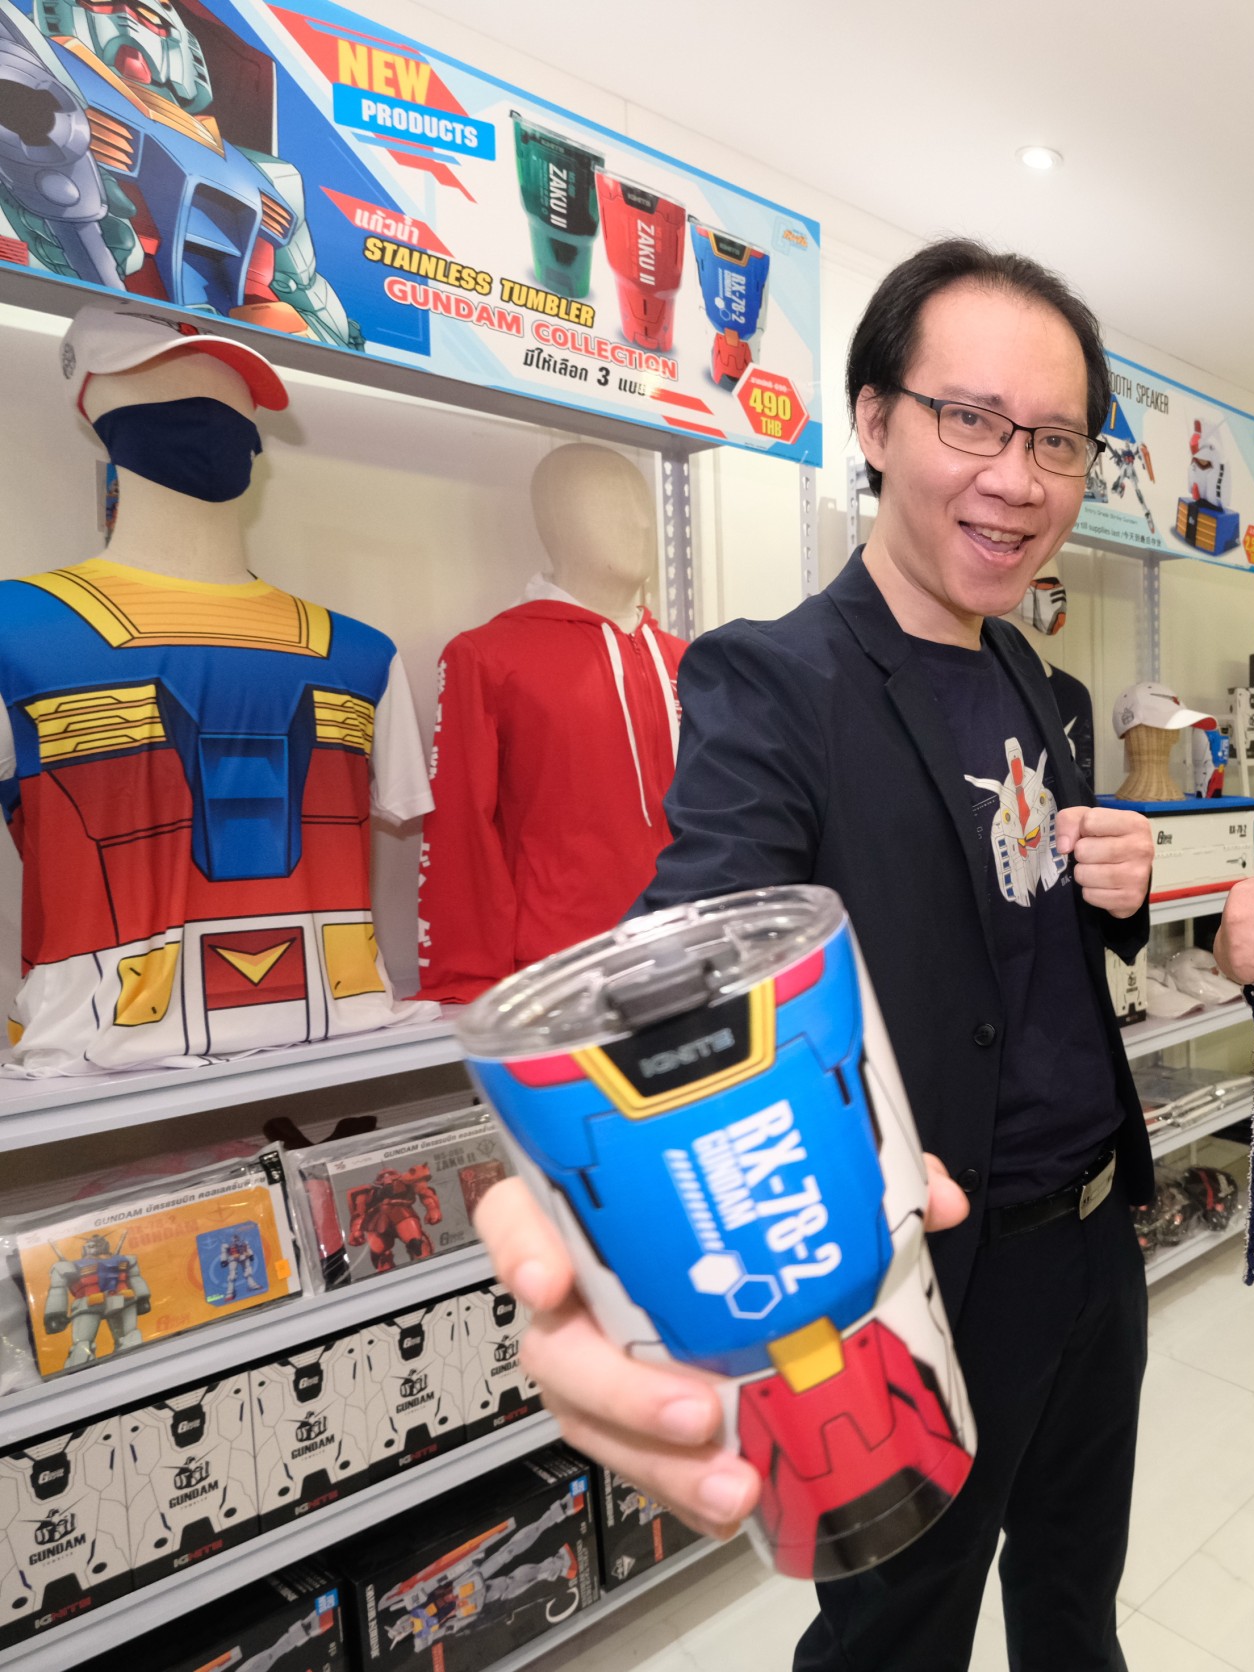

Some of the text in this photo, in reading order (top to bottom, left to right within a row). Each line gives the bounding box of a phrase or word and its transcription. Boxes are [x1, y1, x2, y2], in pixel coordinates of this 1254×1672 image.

[337, 38, 432, 106] NEW
[361, 98, 479, 148] PRODUCTS
[549, 162, 567, 214] ZAKU
[354, 207, 420, 245] แก้วน้ำ
[637, 219, 655, 267] ZAKU
[363, 235, 595, 328] STAINLESS TUMBLER
[384, 276, 679, 380] GUNDAM COLLECTION
[523, 347, 588, 381] มีให้เลือก
[597, 366, 610, 386] 3
[749, 387, 792, 421] 490
[1136, 382, 1169, 415] SPEAKER
[761, 417, 782, 437] THB
[638, 1027, 736, 1078] IGNITE
[383, 1143, 419, 1159] GUNDAM
[691, 1128, 759, 1231] GUNDAM
[724, 1099, 843, 1296] RX-78-2
[94, 1208, 142, 1227] GUNDAM
[395, 1391, 435, 1414] GUNDAM
[291, 1434, 335, 1460] GUNDAM
[168, 1480, 219, 1509] GUNDAM
[294, 1490, 339, 1515] IGNITE
[29, 1533, 86, 1566] GUNDAM
[173, 1539, 223, 1568] IGNITE
[34, 1596, 92, 1629] IGNITE
